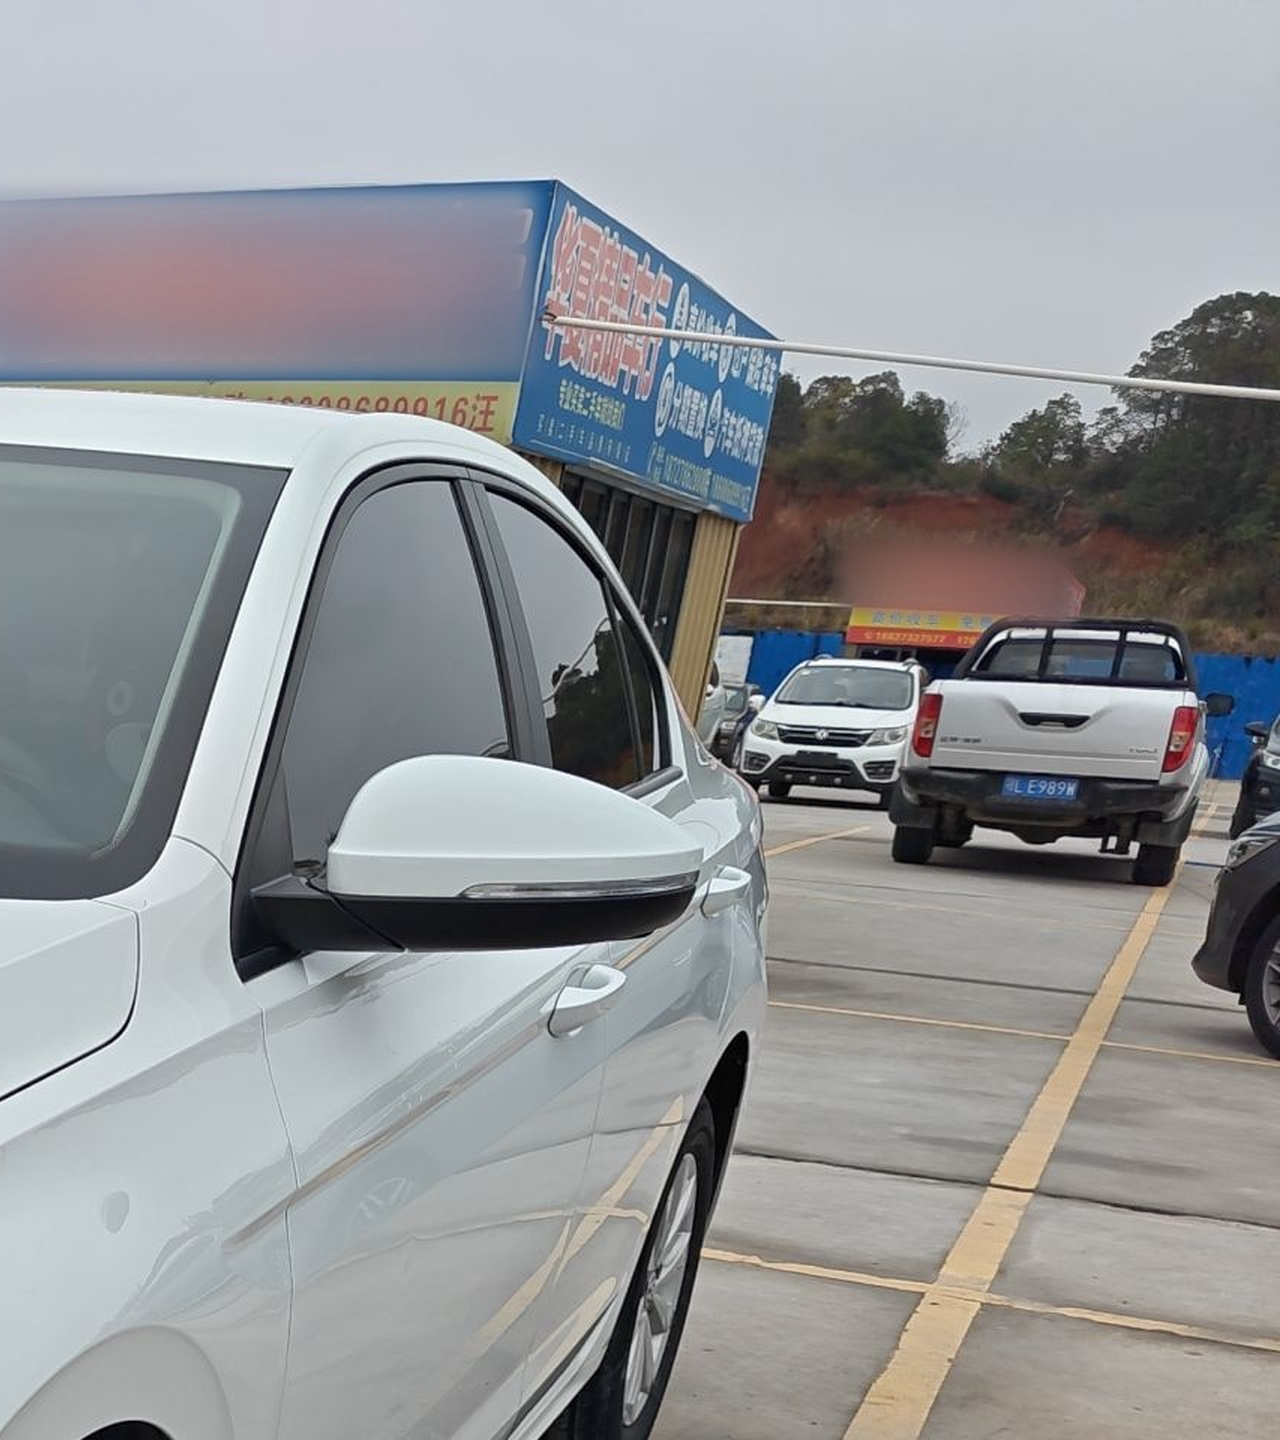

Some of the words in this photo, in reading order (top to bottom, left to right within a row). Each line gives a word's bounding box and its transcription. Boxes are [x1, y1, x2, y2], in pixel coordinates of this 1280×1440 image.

[542, 200, 674, 402] 华夏精品车行
